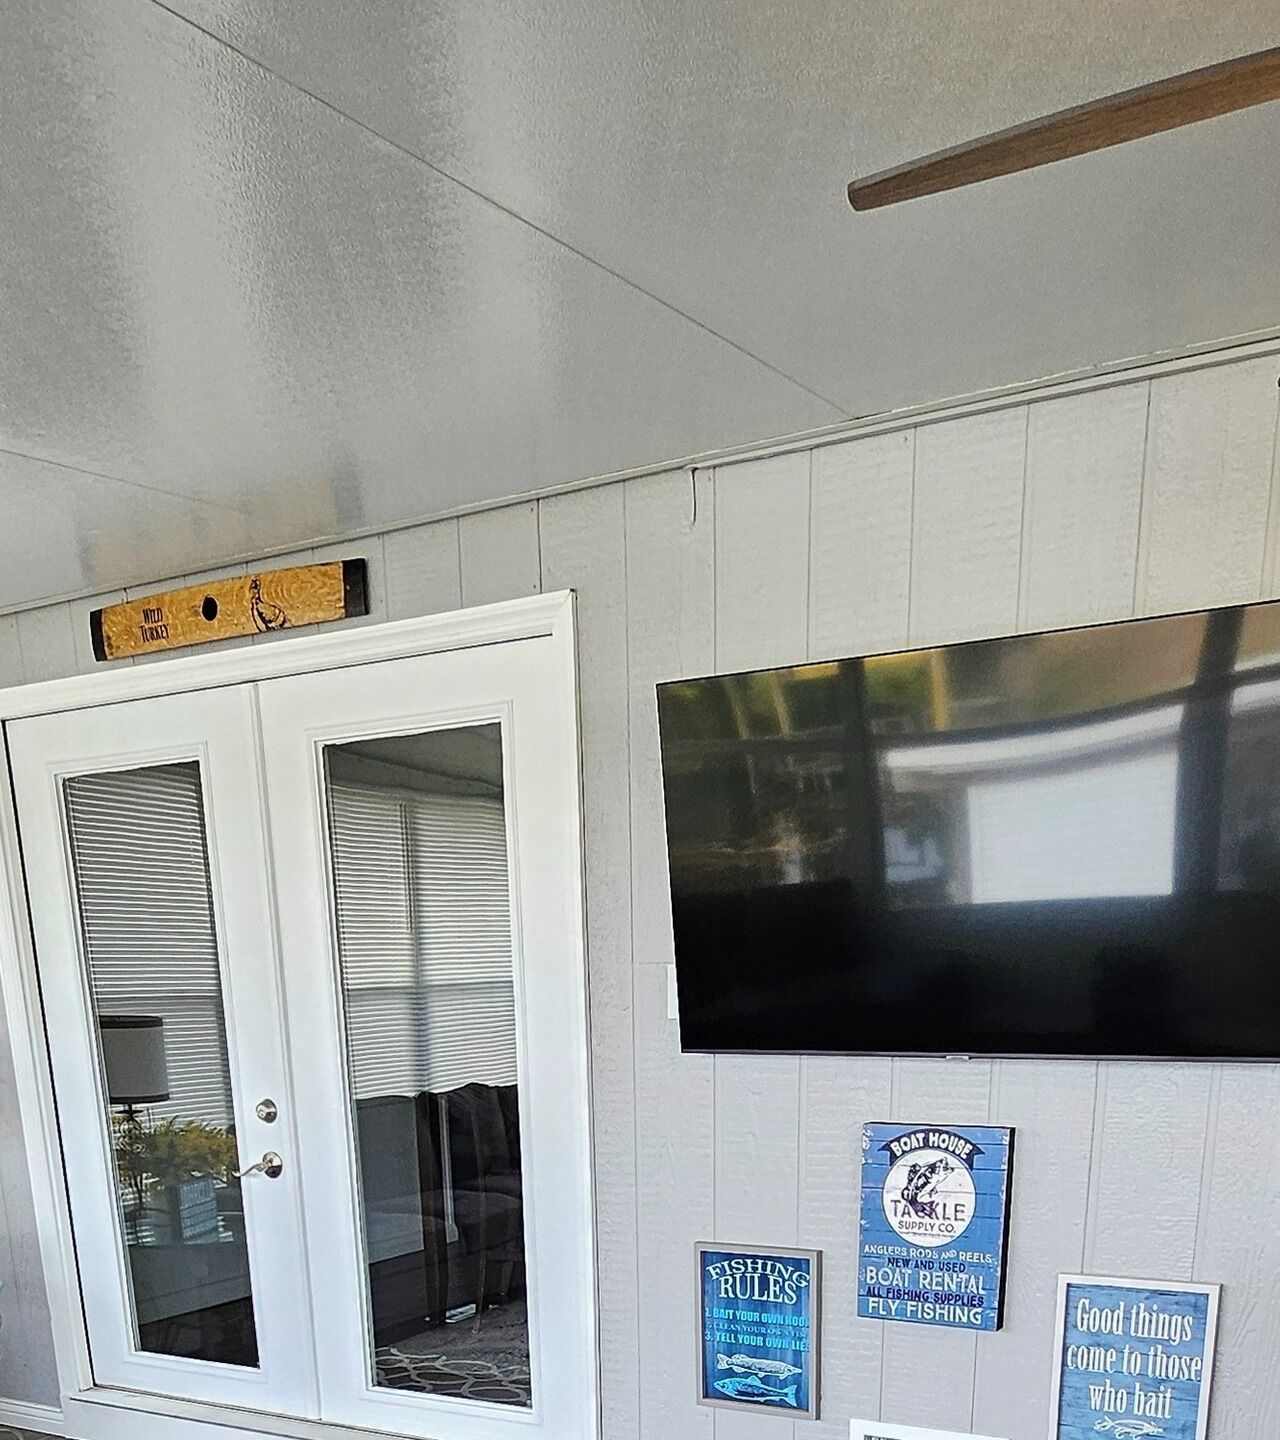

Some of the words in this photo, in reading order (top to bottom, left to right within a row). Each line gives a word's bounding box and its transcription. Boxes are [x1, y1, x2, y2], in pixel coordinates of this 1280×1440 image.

[142, 607, 163, 625] WILD
[138, 623, 169, 643] TURKEY
[890, 1132, 925, 1157] BOAT
[928, 1132, 973, 1160] HOUSE
[898, 1220, 936, 1232] SUPPLY
[938, 1222, 957, 1234] CO.
[864, 1244, 907, 1256] ANGLERS
[909, 1248, 939, 1259] RODS
[706, 1258, 810, 1288] FISHING
[887, 1257, 911, 1269] NEW
[913, 1260, 935, 1271] AND
[938, 1261, 966, 1273] USED
[718, 1273, 797, 1305] RULES
[866, 1266, 912, 1288] BOAT
[919, 1271, 986, 1295] RENTAL
[866, 1286, 884, 1297] ALL
[886, 1287, 930, 1301] FISHING
[932, 1292, 985, 1308] SUPPLIES
[713, 1308, 734, 1320] BAIT
[735, 1310, 760, 1323] YOUR
[761, 1313, 784, 1325] OWN
[868, 1297, 899, 1315] FLY
[906, 1301, 983, 1325] FISHING
[1076, 1297, 1125, 1336] Good
[1129, 1303, 1194, 1346] things
[742, 1324, 767, 1334] YOUR
[705, 1331, 714, 1341] 3.
[716, 1332, 736, 1344] TELL
[737, 1334, 764, 1347] YOUR
[765, 1337, 789, 1350] OWN
[1066, 1344, 1118, 1374] come
[1122, 1344, 1141, 1376] to
[1147, 1345, 1202, 1383] those
[1088, 1379, 1128, 1414] who
[1132, 1382, 1173, 1419] bait
